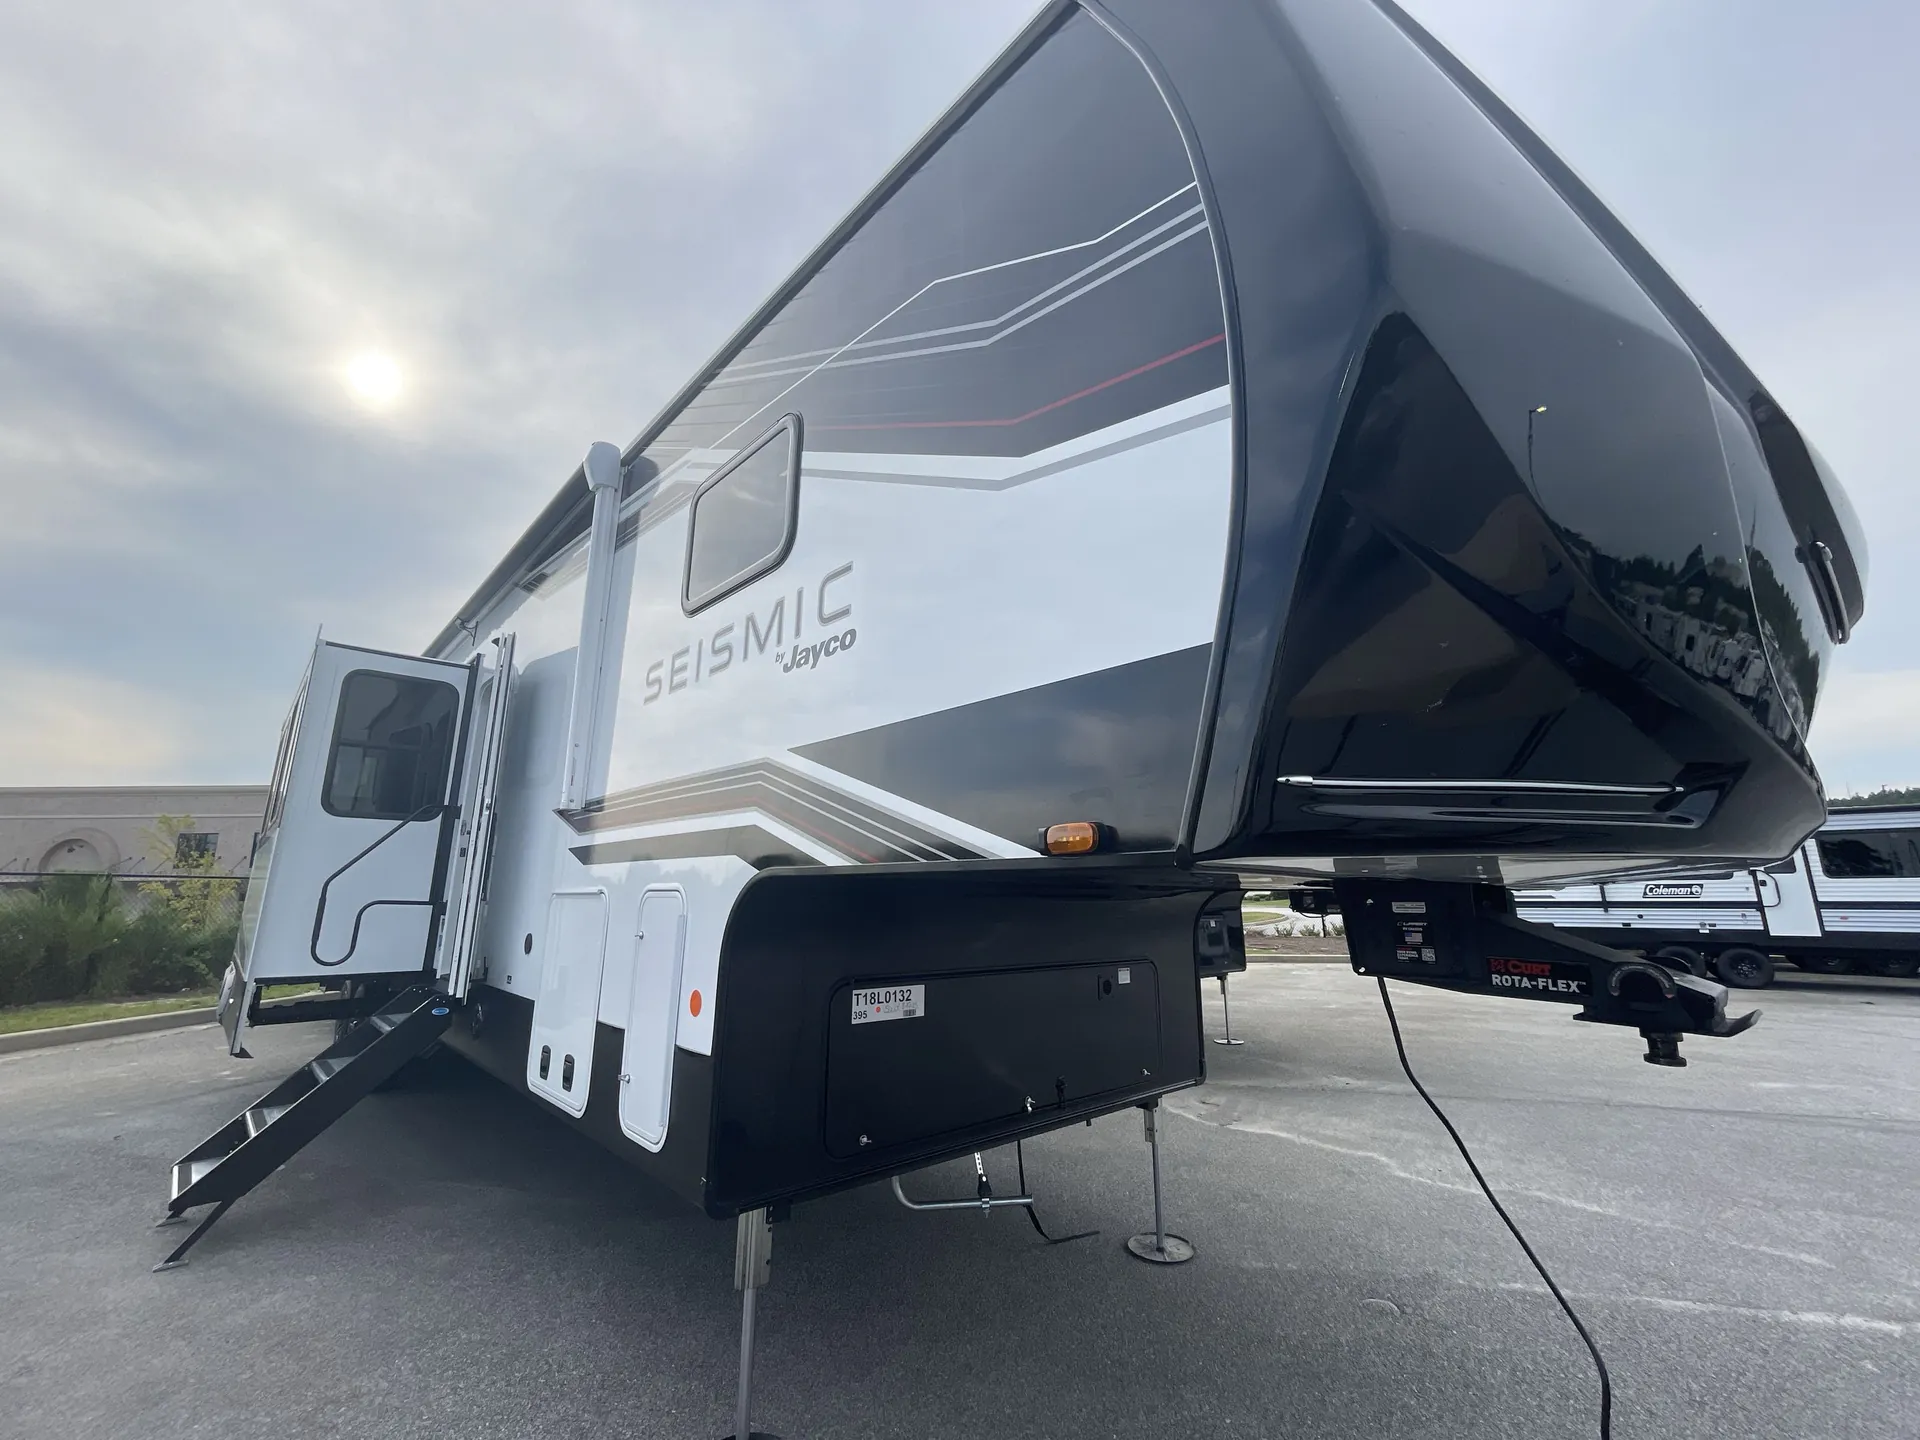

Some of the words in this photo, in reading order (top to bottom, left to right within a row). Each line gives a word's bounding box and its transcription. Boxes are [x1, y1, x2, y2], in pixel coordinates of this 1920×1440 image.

[643, 560, 854, 706] SEISMIC
[775, 651, 786, 664] by
[782, 628, 857, 674] Jayco
[1645, 884, 1691, 896] Coleman
[853, 988, 912, 1007] T18L0132
[852, 1010, 868, 1020] 395
